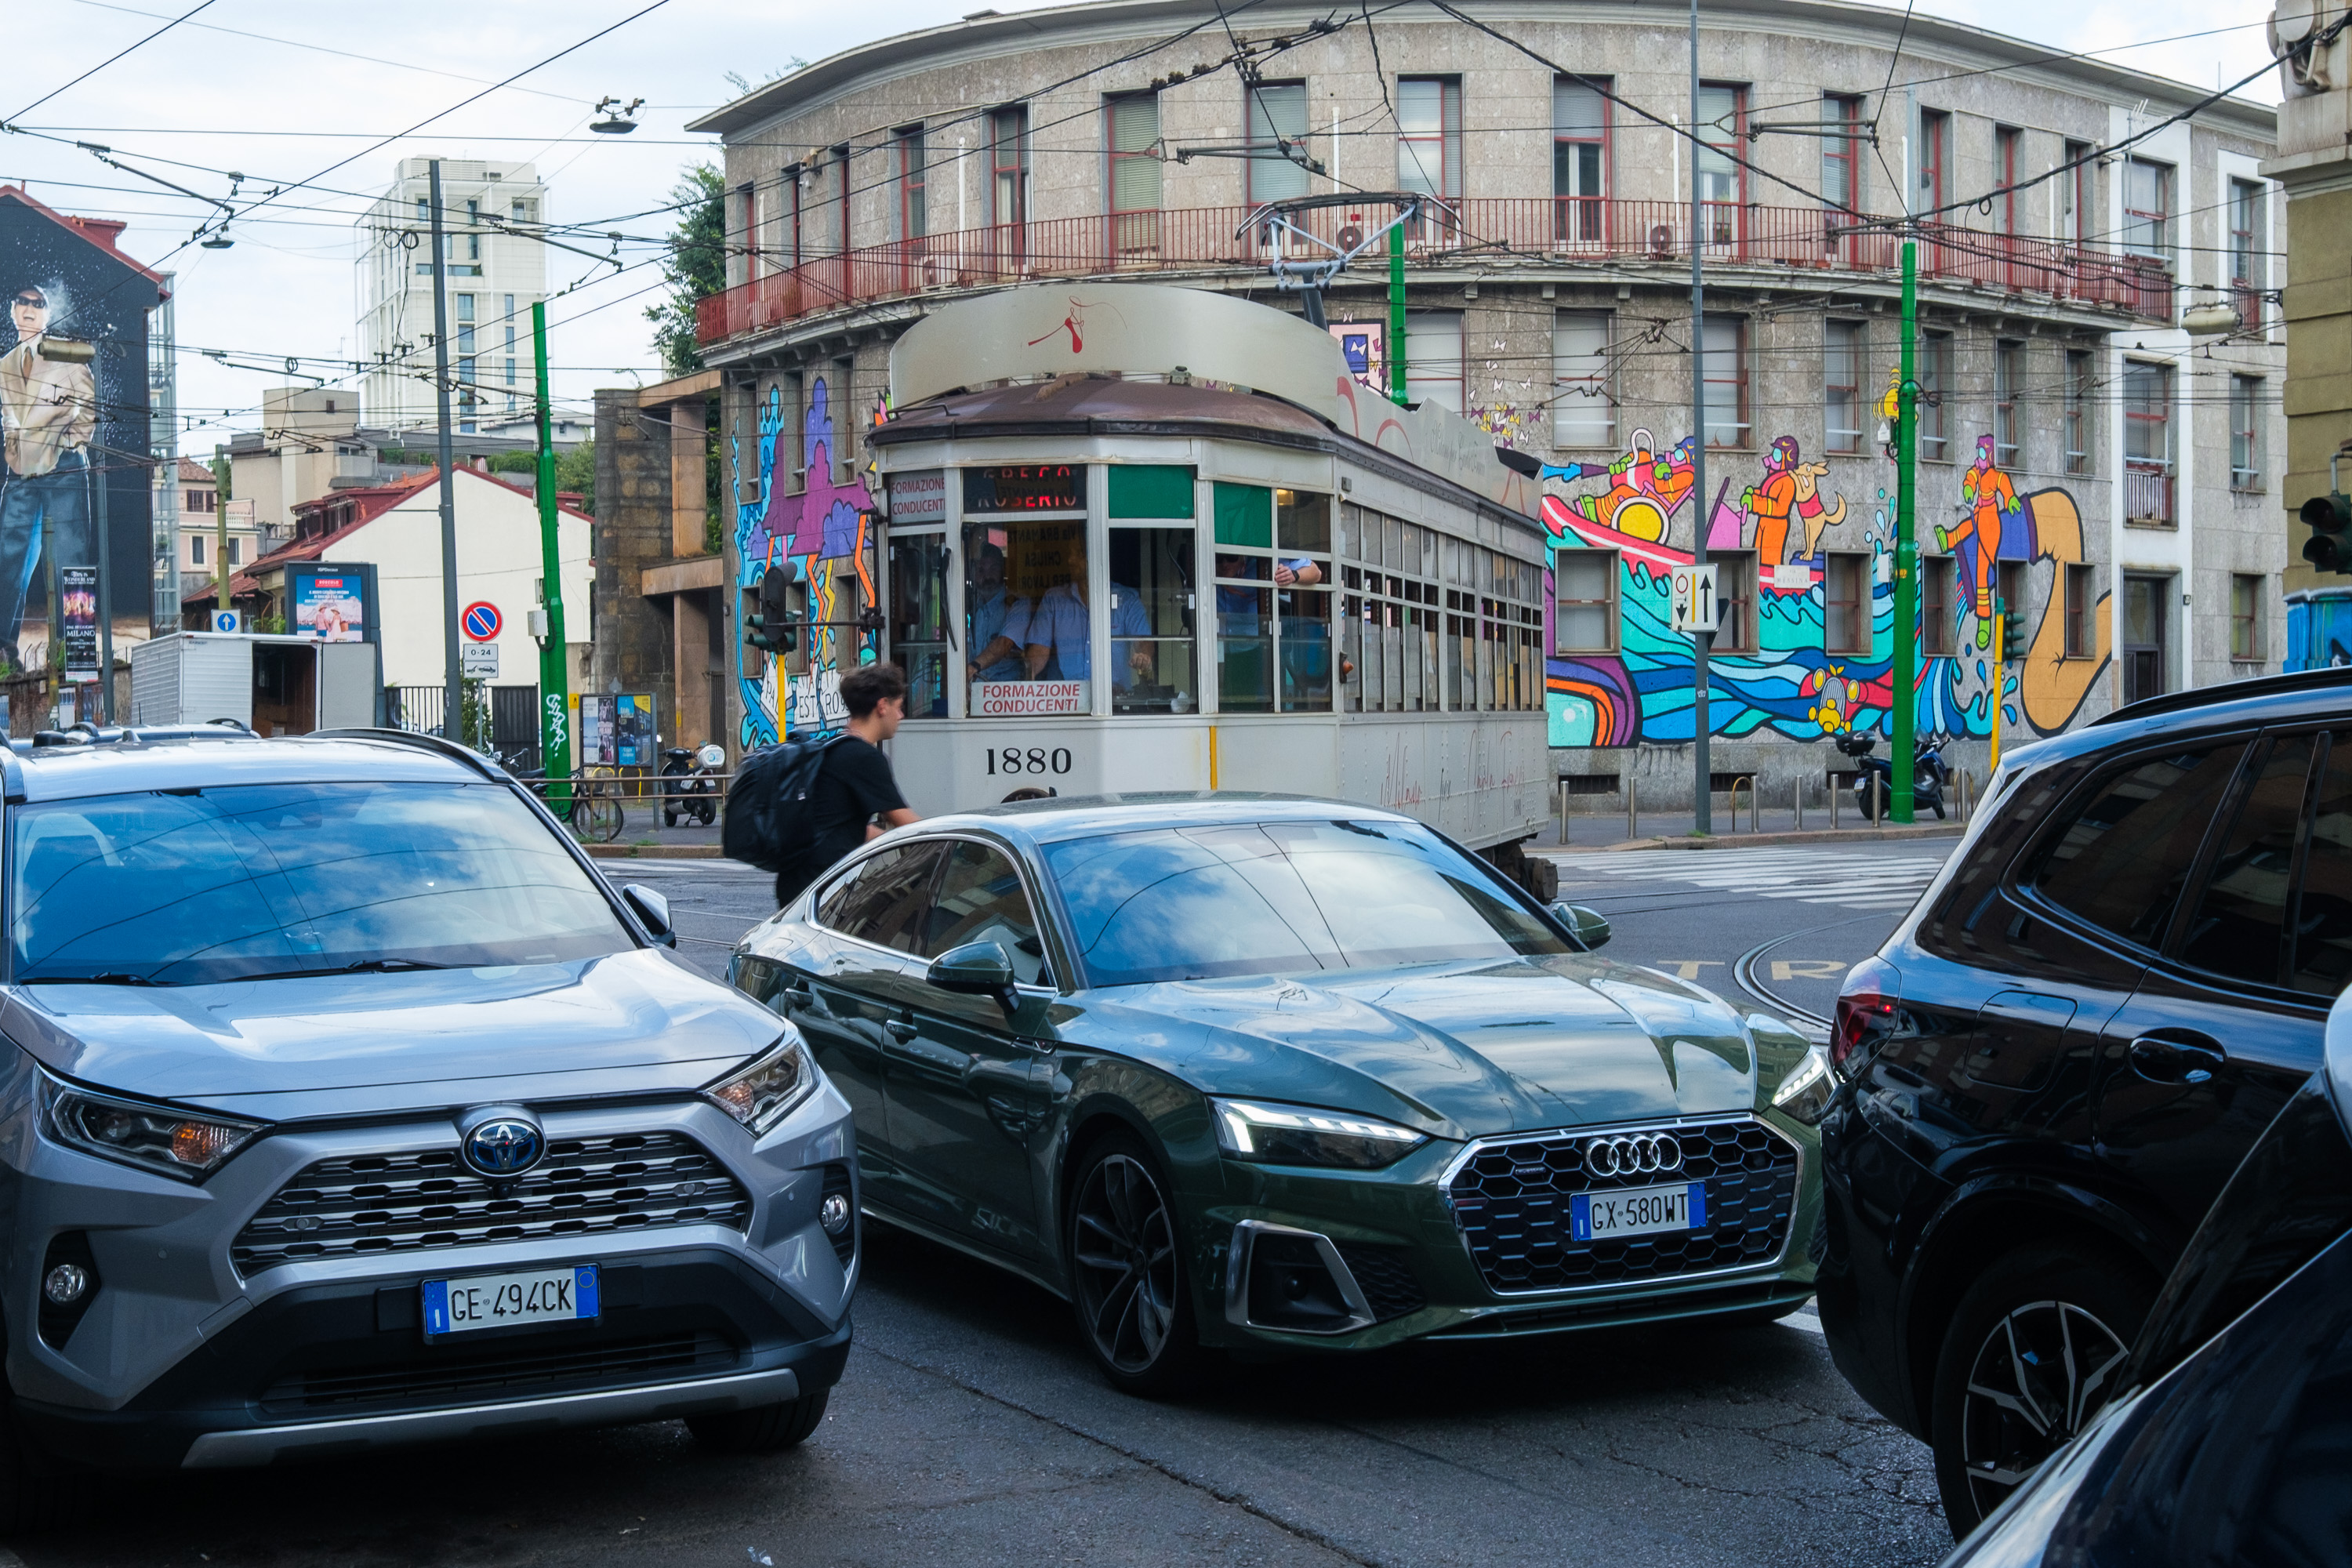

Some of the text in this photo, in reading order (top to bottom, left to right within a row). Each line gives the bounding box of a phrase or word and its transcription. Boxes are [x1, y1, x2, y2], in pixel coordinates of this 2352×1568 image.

[891, 477, 945, 495] FORMAZIONE
[891, 497, 946, 516] CONDUCENTI
[982, 684, 1080, 699] FORMAZIONE
[983, 699, 1079, 713] CONDUCENTI
[986, 747, 1073, 775] 1880
